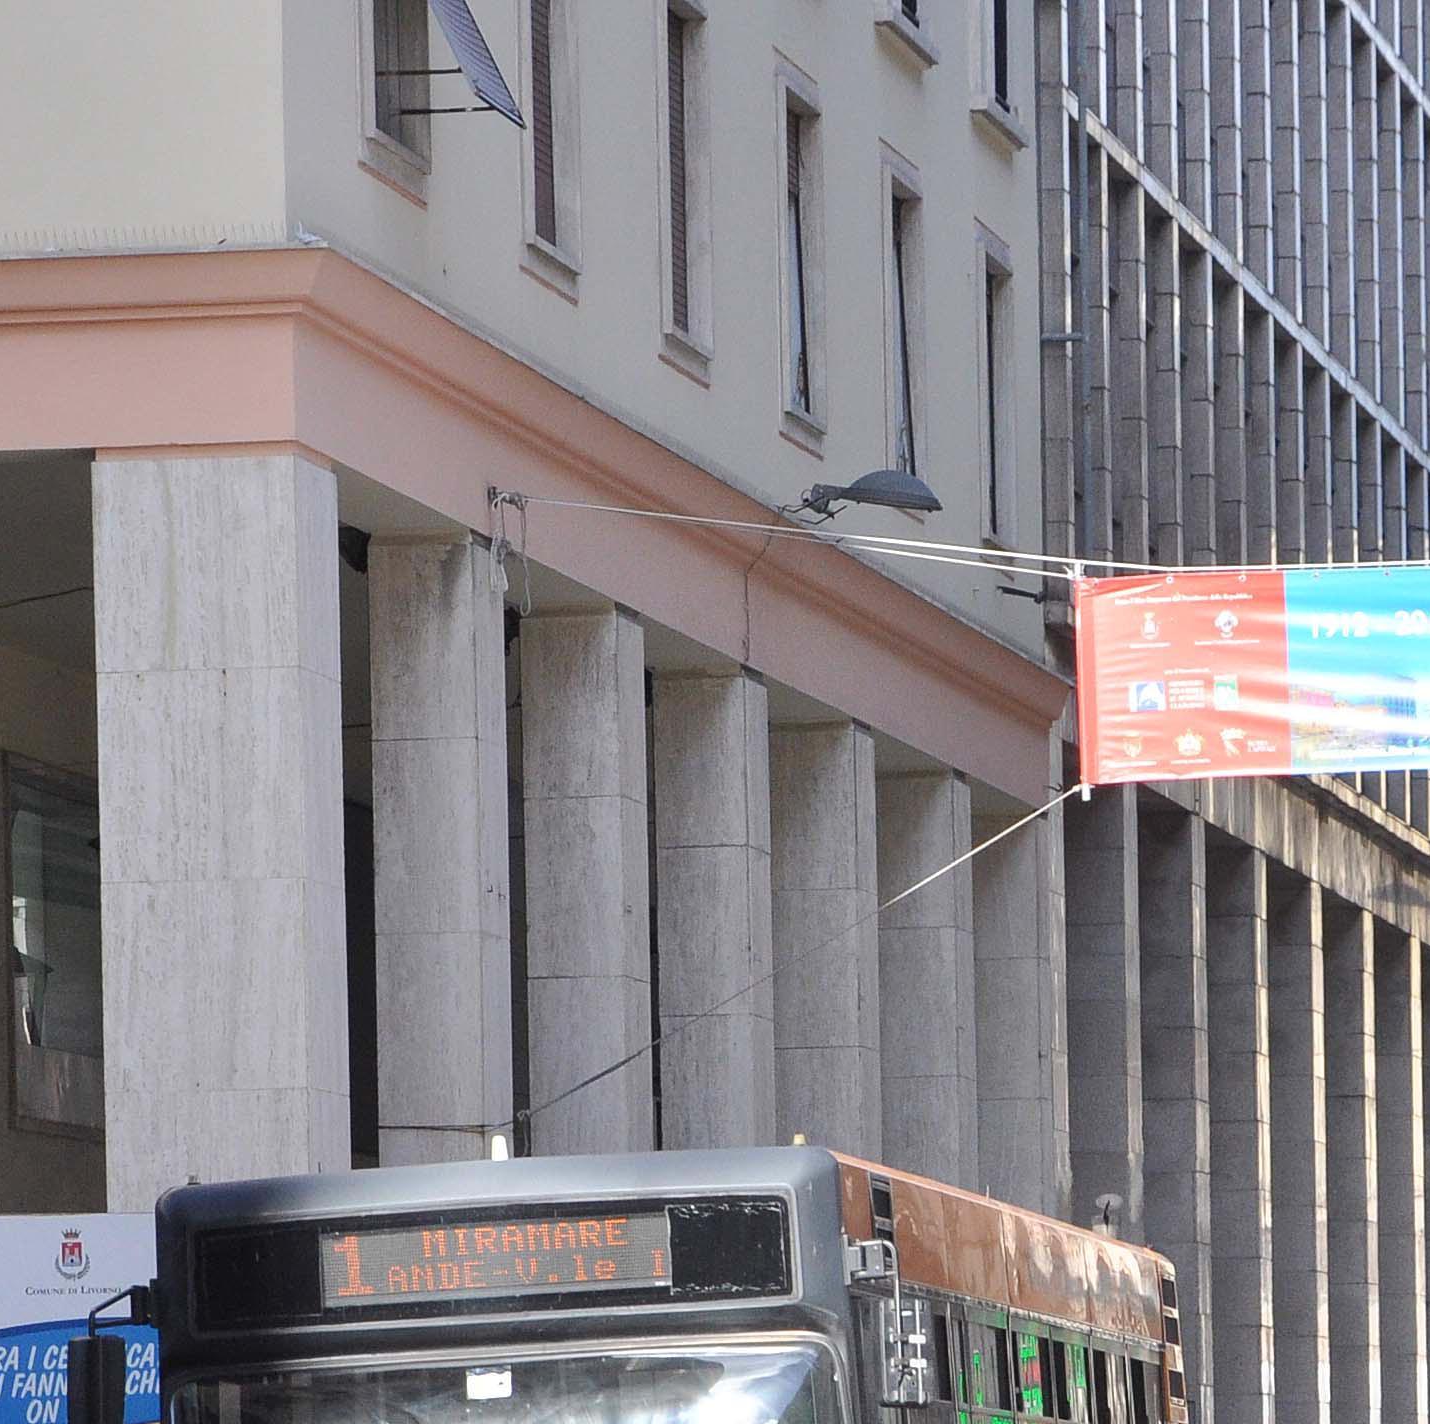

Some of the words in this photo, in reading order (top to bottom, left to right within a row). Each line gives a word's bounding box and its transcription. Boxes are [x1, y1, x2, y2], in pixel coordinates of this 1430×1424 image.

[1308, 611, 1371, 639] 1912
[333, 1236, 375, 1298] 1
[421, 1216, 629, 1258] MIRAMARE
[25, 1286, 64, 1296] COMUNE
[81, 1285, 122, 1295] LIVORNO
[27, 1345, 37, 1371] I
[11, 1372, 69, 1399] FANN
